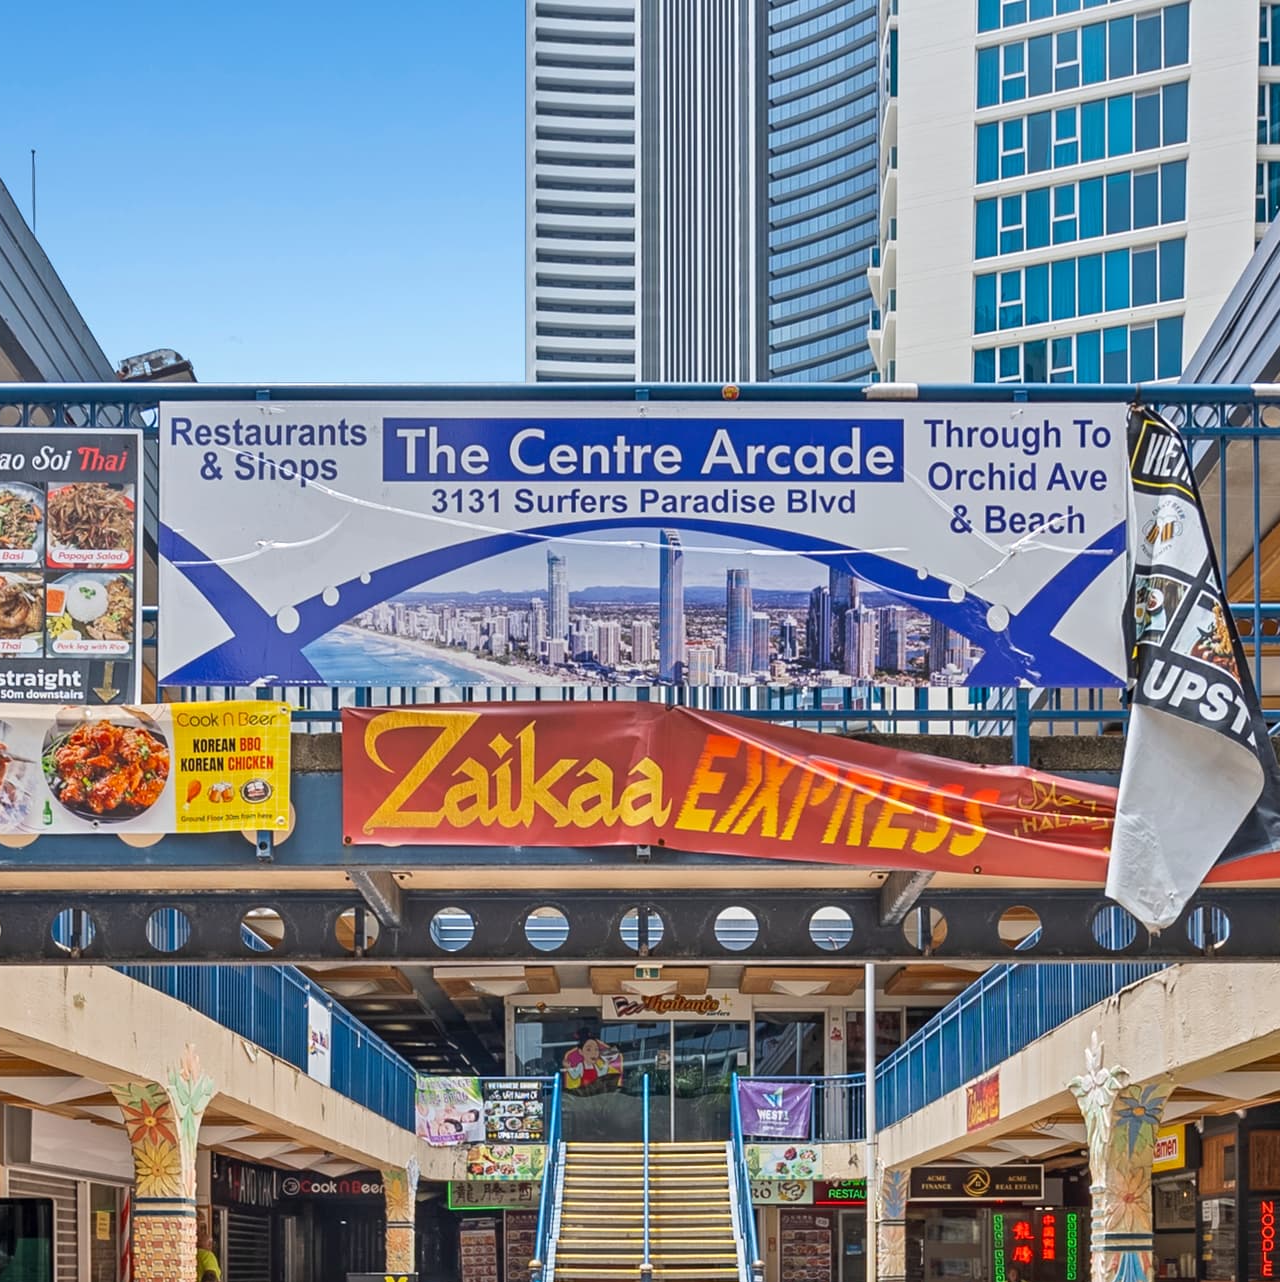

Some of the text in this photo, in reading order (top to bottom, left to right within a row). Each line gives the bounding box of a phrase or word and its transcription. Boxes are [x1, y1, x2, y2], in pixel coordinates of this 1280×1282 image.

[170, 416, 368, 448] Restaurants
[922, 418, 1112, 453] Through To
[31, 445, 72, 471] Soi
[77, 446, 127, 472] Thai
[396, 426, 896, 478] The Centre Arcade
[199, 449, 339, 488] & Shops
[927, 461, 1108, 493] Orchid Ave
[431, 487, 857, 515] 3131 Surfers Paradise Blvd
[949, 504, 1085, 535] & Beach
[58, 551, 124, 562] Papaya Salad
[1, 641, 22, 650] Thai
[0, 689, 24, 700] 50m
[26, 688, 85, 701] downstairs
[176, 711, 219, 728] Cook
[239, 711, 278, 727] Beer
[193, 737, 261, 753] KOREAN BBQ
[181, 756, 274, 772] KOREAN CHICKEN
[362, 709, 999, 858] Zaikaa EXPRESS
[181, 815, 206, 823] Ground
[207, 814, 224, 822] Floor
[1152, 1135, 1178, 1161] amen
[300, 1179, 337, 1194] Cook
[921, 1183, 953, 1191] FINANCE
[926, 1174, 947, 1183] ACME
[995, 1183, 1040, 1191] REAL ESTATE
[1007, 1174, 1028, 1183] ACME
[1260, 1200, 1276, 1278] NOODLE
